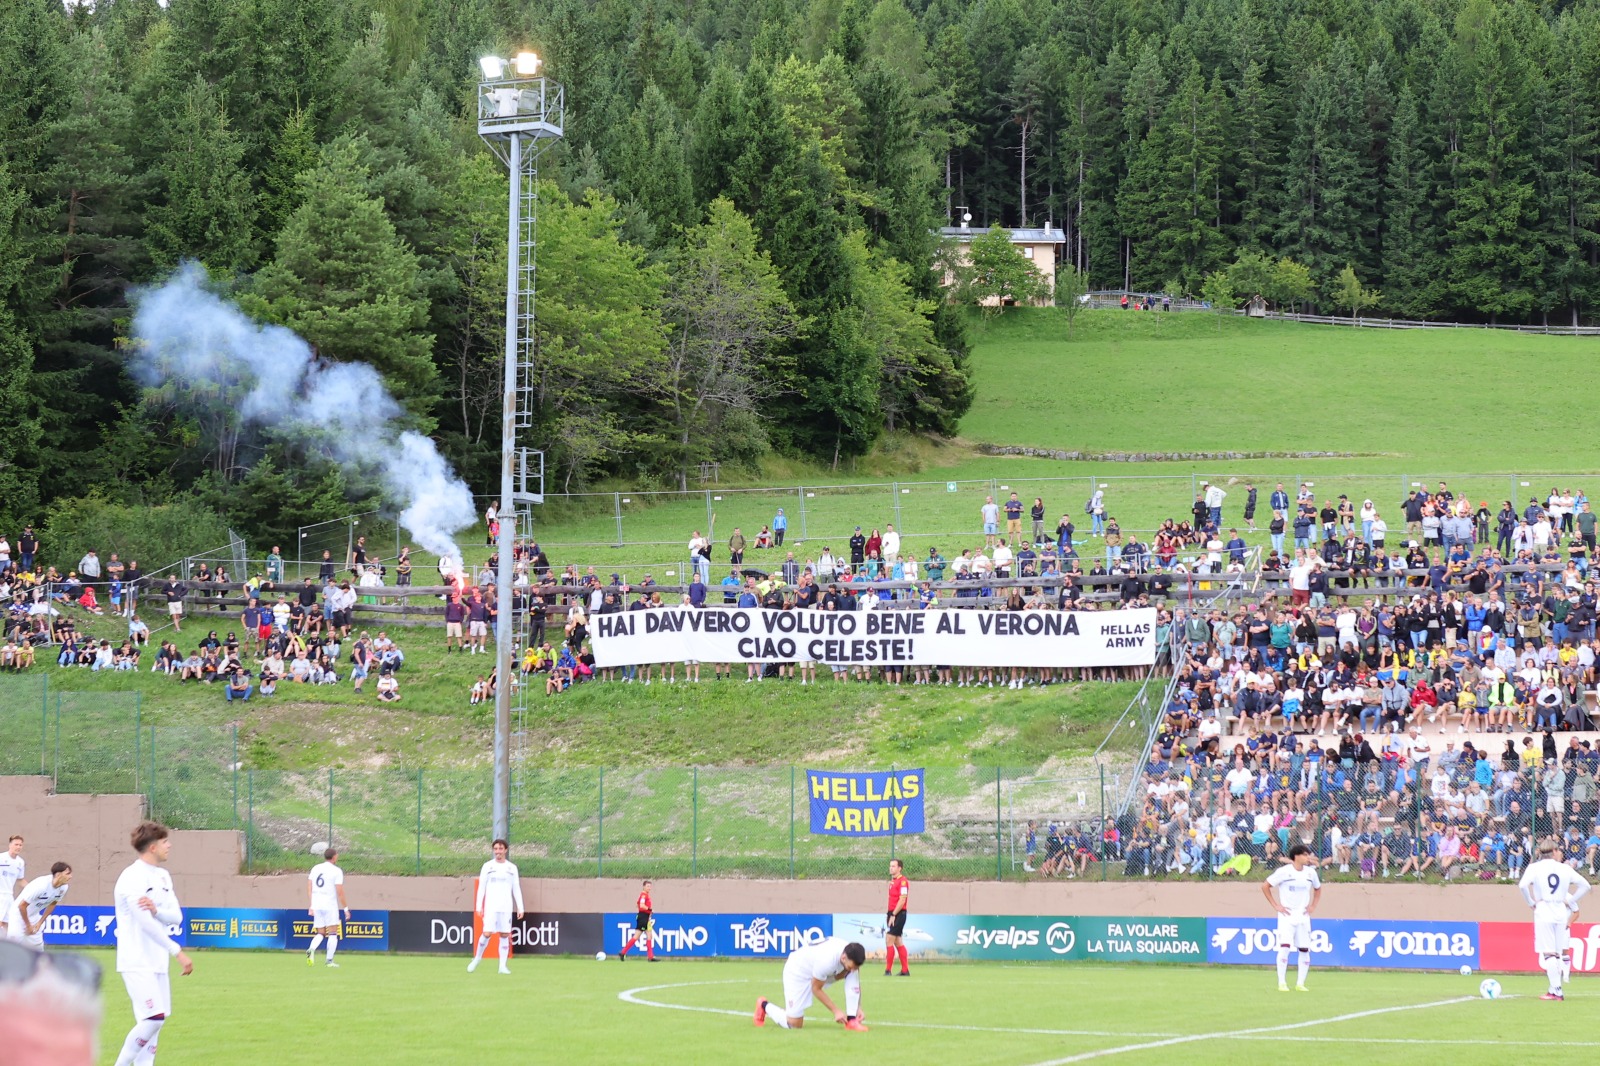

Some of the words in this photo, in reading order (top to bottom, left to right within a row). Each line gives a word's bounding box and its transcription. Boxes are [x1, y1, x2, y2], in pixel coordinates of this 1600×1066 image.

[598, 614, 635, 638] HAI
[645, 610, 750, 634] DAVVERO
[762, 611, 856, 636] VOLUTO
[866, 612, 925, 635] BENE
[935, 612, 966, 635] AL
[978, 613, 1080, 636] VERONA
[1100, 623, 1151, 635] HELLAS
[738, 637, 797, 659] CIAO
[808, 639, 914, 662] CELESTE!
[1105, 637, 1145, 648] ARMY
[811, 774, 920, 802] HELLAS
[823, 805, 909, 832] ARMY
[315, 873, 325, 888] 6
[1547, 873, 1560, 894] 9
[190, 922, 206, 932] WE
[207, 922, 226, 932] ARE
[241, 923, 278, 933] HELLAS
[293, 925, 309, 934] WE
[345, 925, 384, 935] HELLAS
[1107, 924, 1123, 937] FA
[1126, 924, 1178, 937] VOLARE
[730, 923, 825, 953] TRENTINO
[956, 925, 1039, 949] skyalps
[1237, 928, 1333, 955] Joa
[1087, 940, 1104, 952] LA
[1106, 940, 1133, 953] TUA
[1136, 940, 1200, 954] SQUADRA
